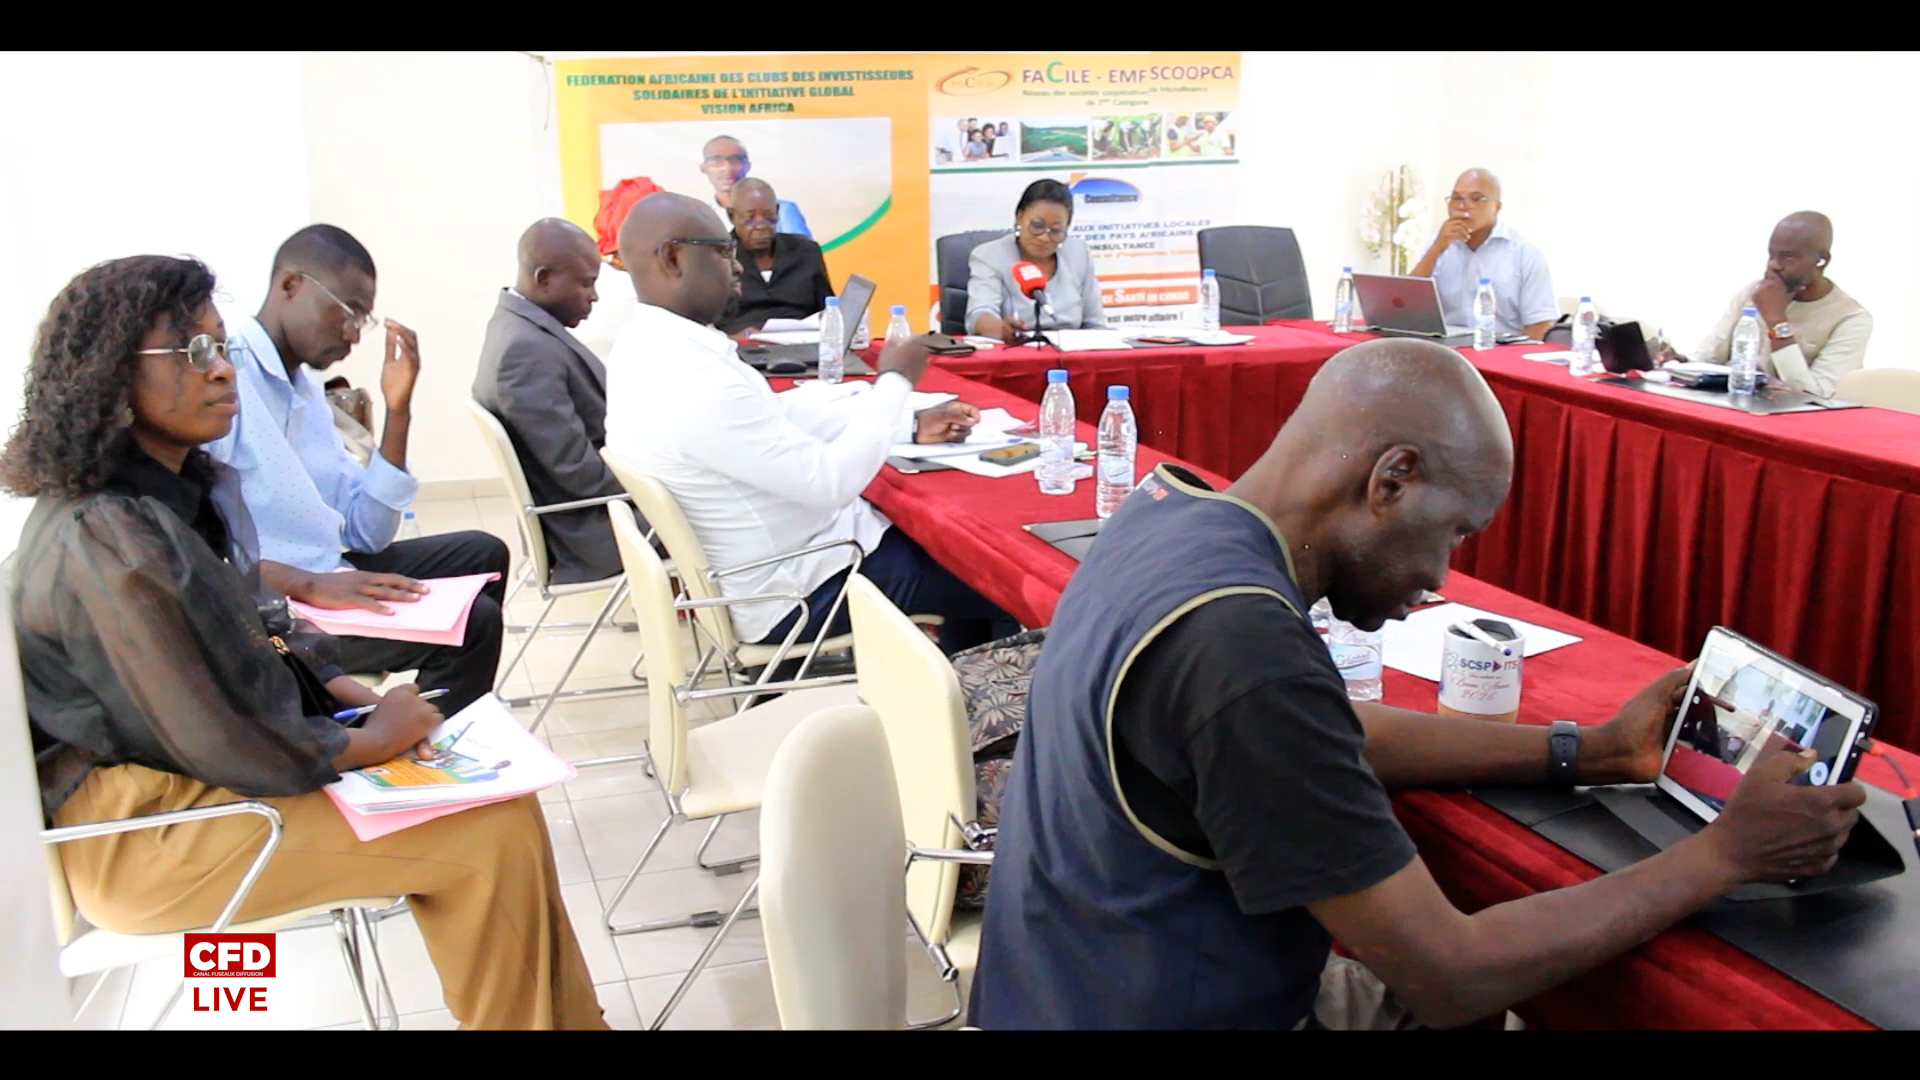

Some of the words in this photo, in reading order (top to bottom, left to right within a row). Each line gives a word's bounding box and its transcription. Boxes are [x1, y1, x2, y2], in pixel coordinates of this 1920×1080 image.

[567, 74, 645, 86] FEDERATION
[650, 73, 716, 84] AFRICAINE
[720, 72, 743, 83] DES
[747, 71, 788, 82] CLUBS
[792, 71, 815, 82] DES
[819, 70, 913, 81] INVESTISSEURS
[1109, 69, 1148, 83] EMF
[1150, 65, 1234, 80] SCOOPCA
[633, 89, 709, 100] SOLIDAIRES
[713, 88, 728, 98] DE
[732, 87, 806, 98] L'INITIATIVE
[809, 86, 854, 97] GLOBAL
[701, 103, 745, 114] VISION
[749, 102, 794, 113] AFRICA
[1098, 221, 1160, 231] INITIATIVES
[1164, 219, 1211, 228] LOCALES
[1460, 658, 1492, 671] SCSP
